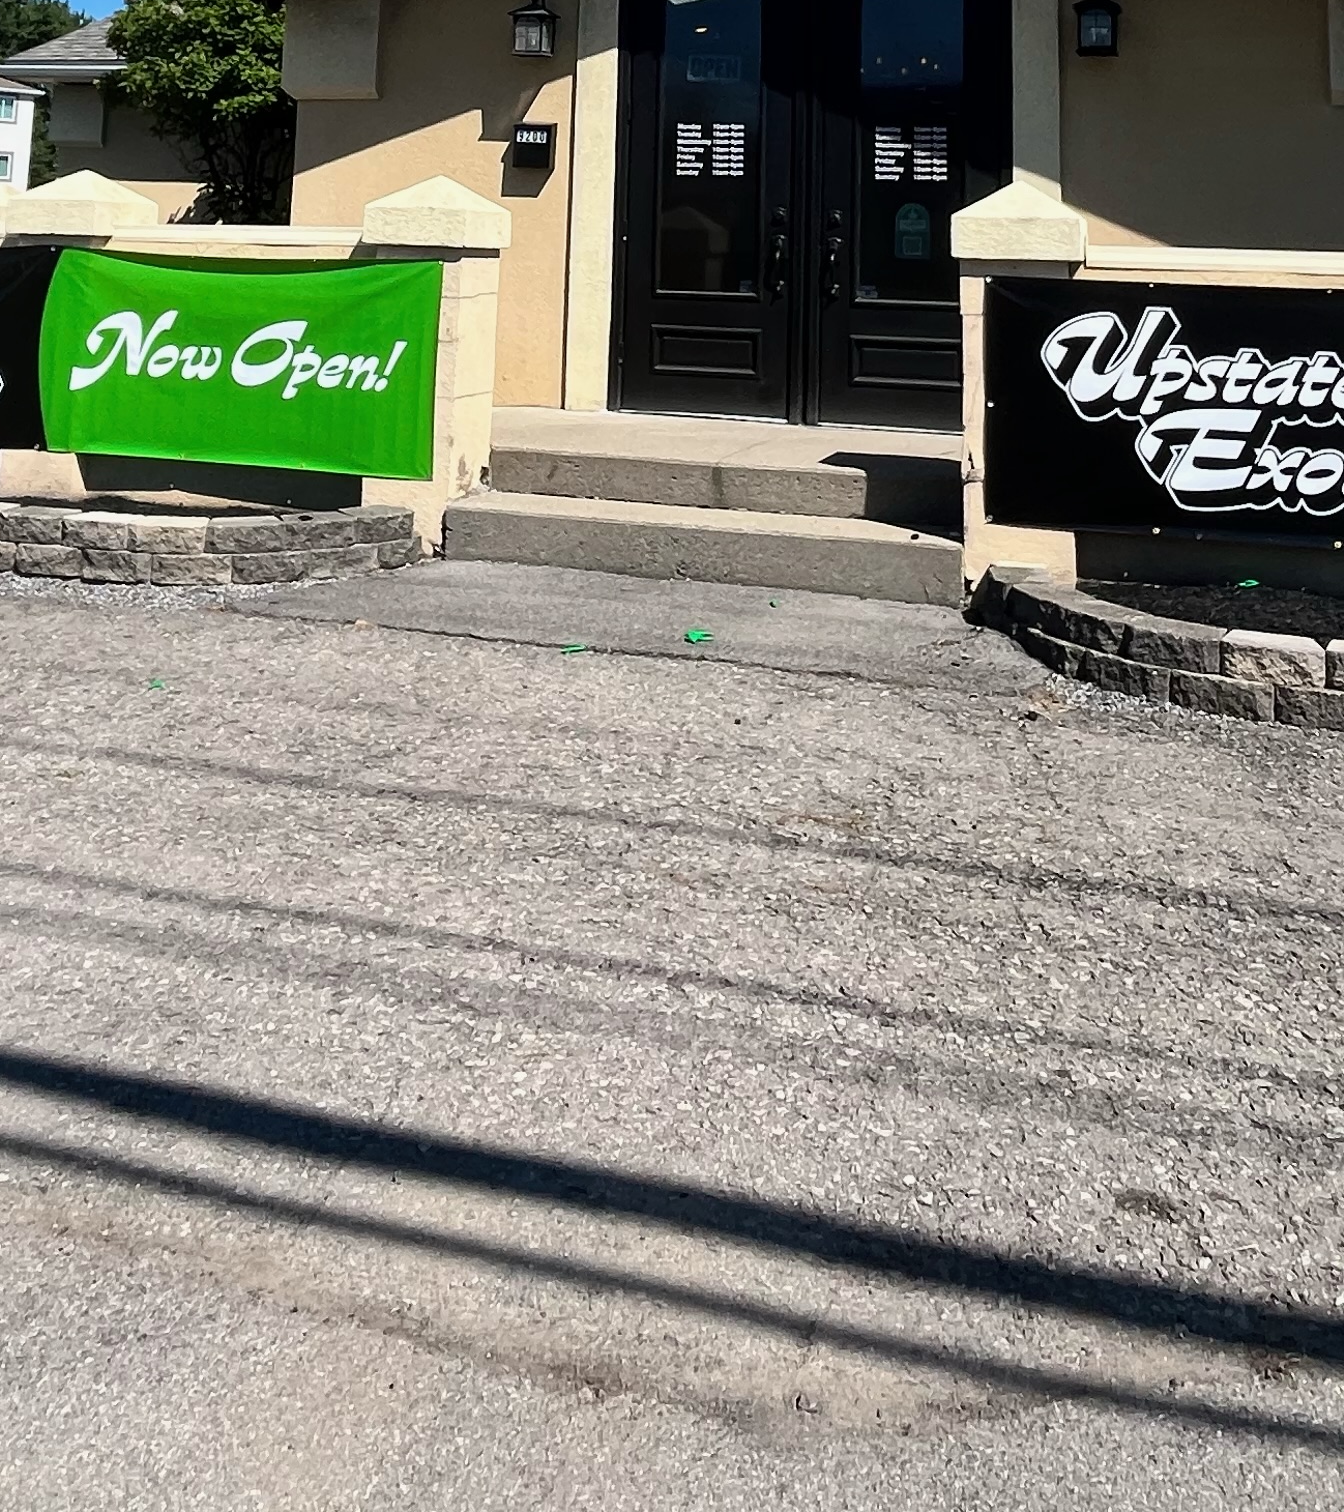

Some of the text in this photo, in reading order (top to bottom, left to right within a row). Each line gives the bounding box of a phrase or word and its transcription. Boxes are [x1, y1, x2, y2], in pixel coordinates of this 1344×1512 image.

[517, 130, 546, 142] 9200
[68, 309, 408, 401] Now Open!
